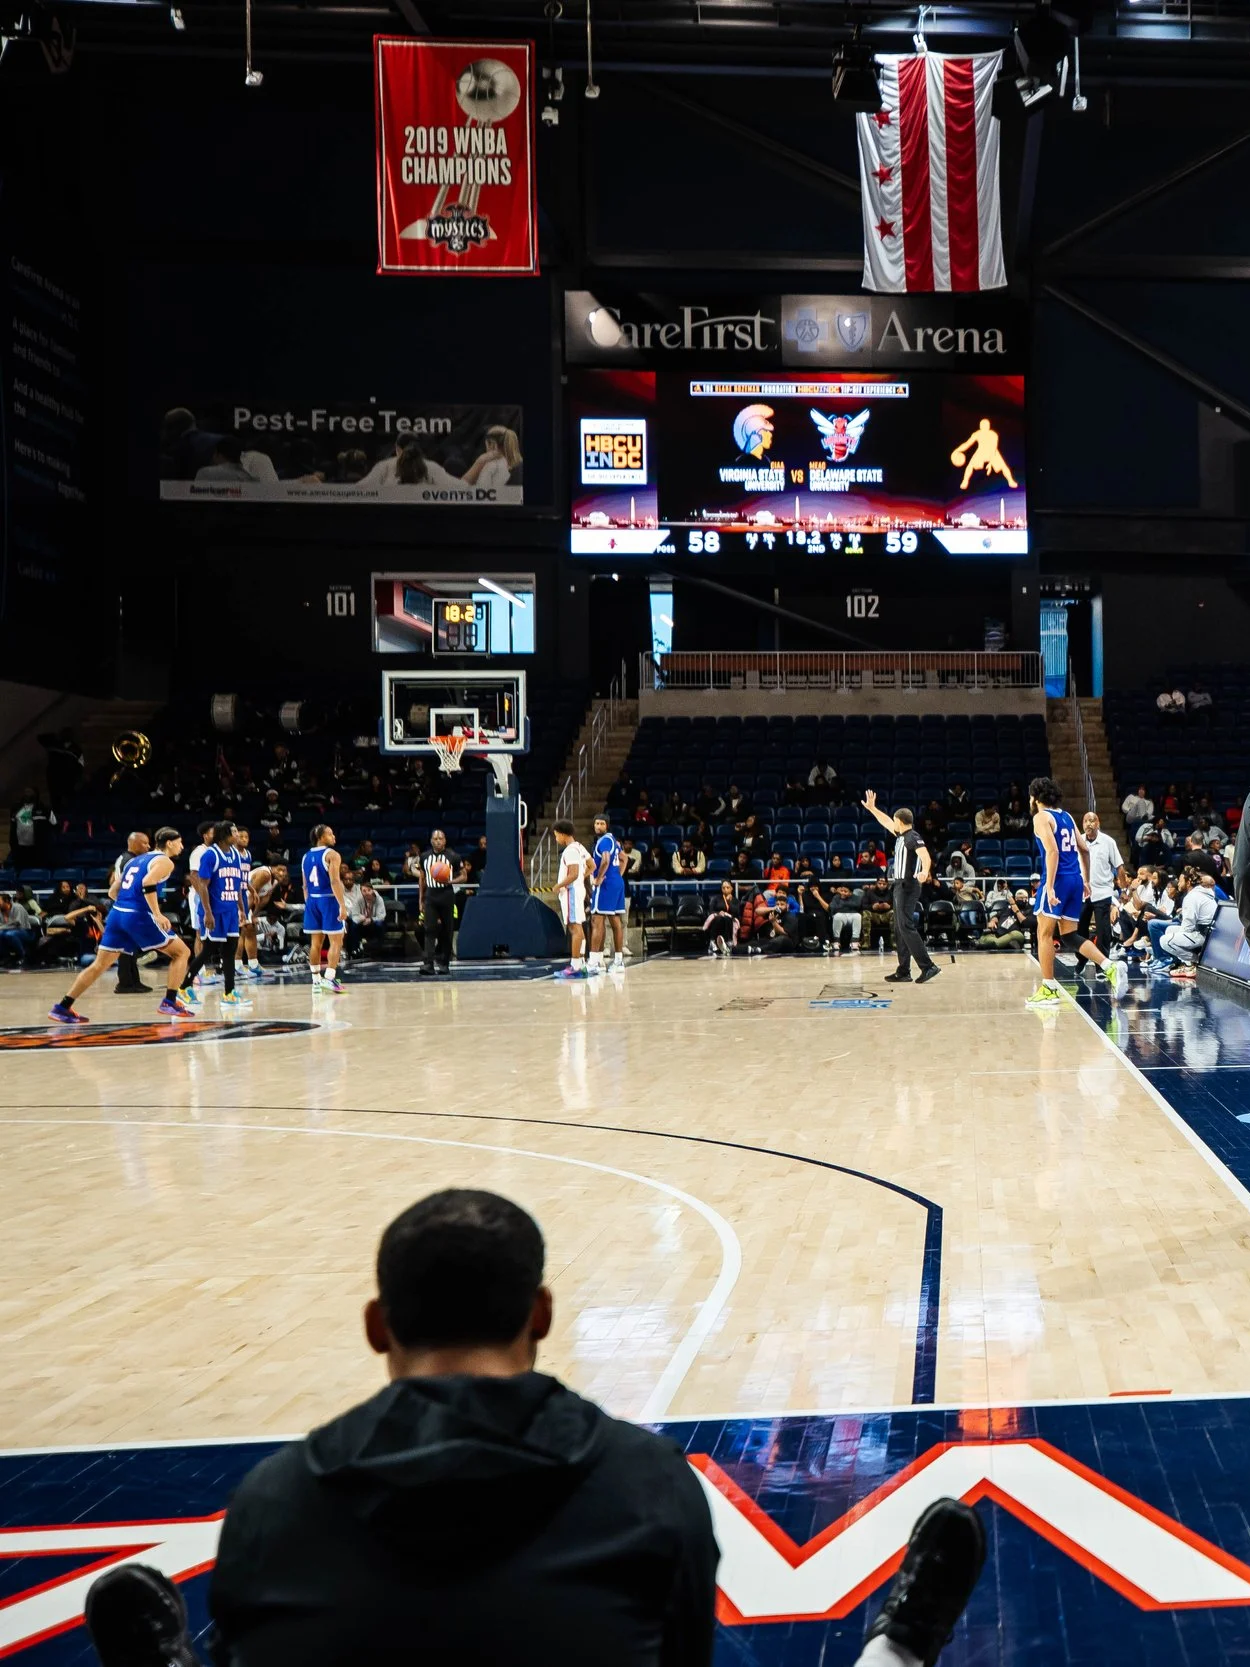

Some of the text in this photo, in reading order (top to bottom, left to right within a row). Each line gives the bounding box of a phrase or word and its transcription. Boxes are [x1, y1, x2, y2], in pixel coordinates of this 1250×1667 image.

[404, 126, 508, 155] 2019 WNBA
[402, 156, 512, 185] CHAMPIONS
[877, 308, 1007, 354] Arena
[233, 407, 452, 434] Pest-Free Team
[585, 435, 642, 452] HBCU
[719, 468, 785, 482] VIRGINIA STATE
[791, 469, 804, 484] VS
[809, 469, 883, 483] DELAWARE STATE
[745, 481, 785, 492] UNIVERSITY
[809, 481, 850, 492] UNIVERSITY
[688, 531, 721, 553] 58
[786, 530, 821, 545] 18.2
[886, 531, 918, 553] 59
[807, 545, 825, 554] 2ND
[326, 592, 355, 616] 101
[445, 604, 475, 623] 18.2
[846, 595, 880, 618] 102
[1060, 828, 1078, 852] 24
[122, 866, 140, 890] 5
[225, 878, 234, 891] 11
[308, 865, 320, 887] 4
